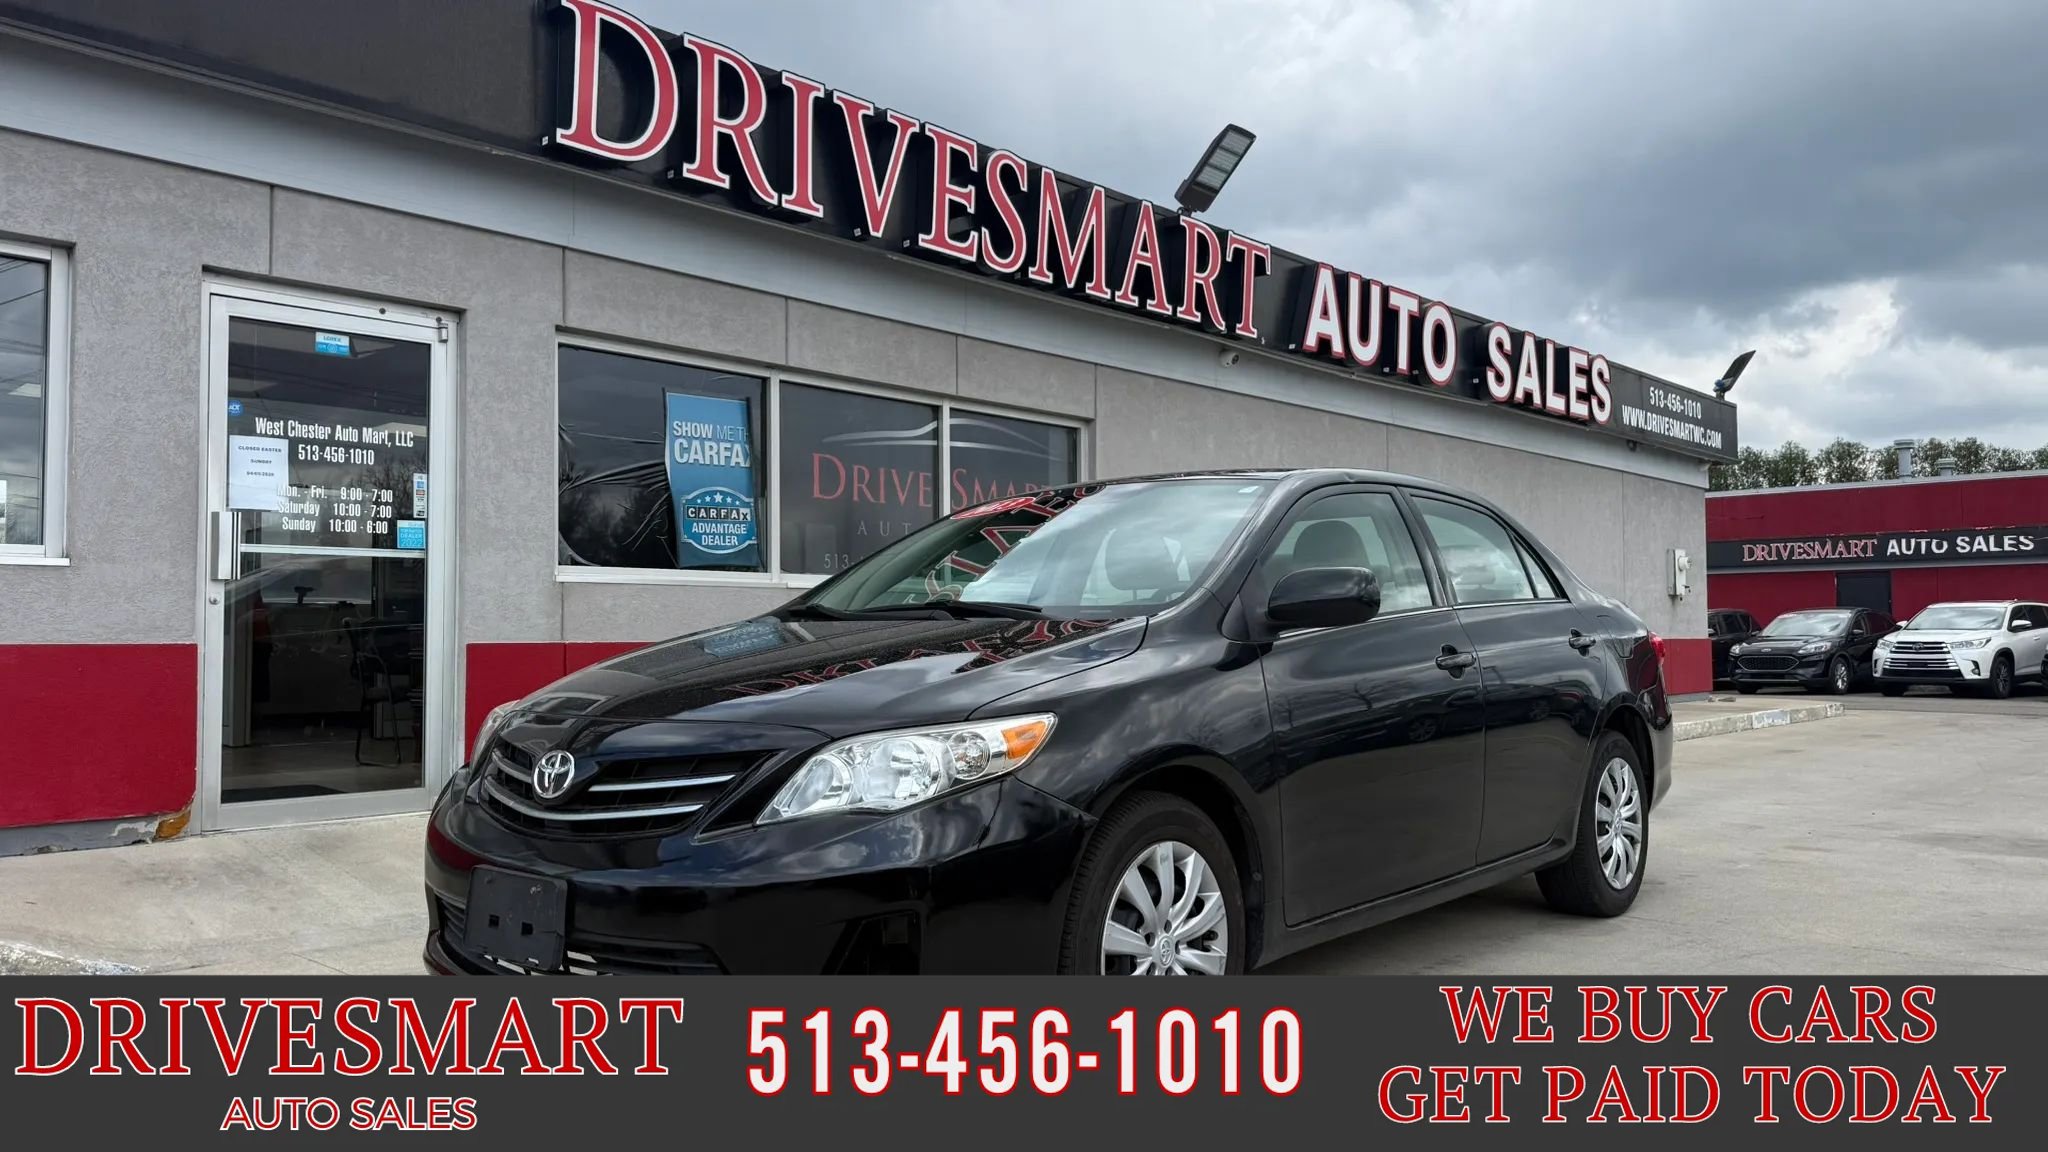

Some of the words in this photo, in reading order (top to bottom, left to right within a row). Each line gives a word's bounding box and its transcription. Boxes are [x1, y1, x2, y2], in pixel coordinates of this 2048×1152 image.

[556, 0, 1271, 338] DRIVESMART
[1303, 262, 1456, 386] AUTO
[1487, 322, 1612, 424] SALES
[1650, 386, 1702, 419] 513-456-1010
[255, 417, 284, 436] West
[288, 420, 331, 440] Chester
[335, 425, 358, 443] Auto
[362, 427, 392, 448] Mart,
[395, 430, 414, 447] LLC
[673, 420, 713, 439] SHOW
[716, 424, 735, 440] ME
[1622, 404, 1722, 449] WWW.DRIVESMARTWC.COM
[298, 444, 375, 465] 513-456-1010
[276, 484, 301, 498] Mon.
[311, 485, 328, 499] Fri.
[340, 487, 362, 500] 9:00
[372, 488, 393, 503] 7:00
[279, 500, 320, 516] Saturday
[333, 503, 361, 517] 10:00
[370, 505, 392, 518] 7:00
[687, 506, 750, 521] CARFAX
[282, 516, 316, 533] Sunday
[329, 519, 357, 533] 10:00
[366, 521, 388, 534] 6:00
[692, 522, 747, 534] ADVANTAGE
[702, 534, 739, 546] DEALER
[1742, 538, 1878, 562] DRIVESMART
[1886, 538, 1948, 557] AUTO
[1955, 535, 2035, 554] SALES
